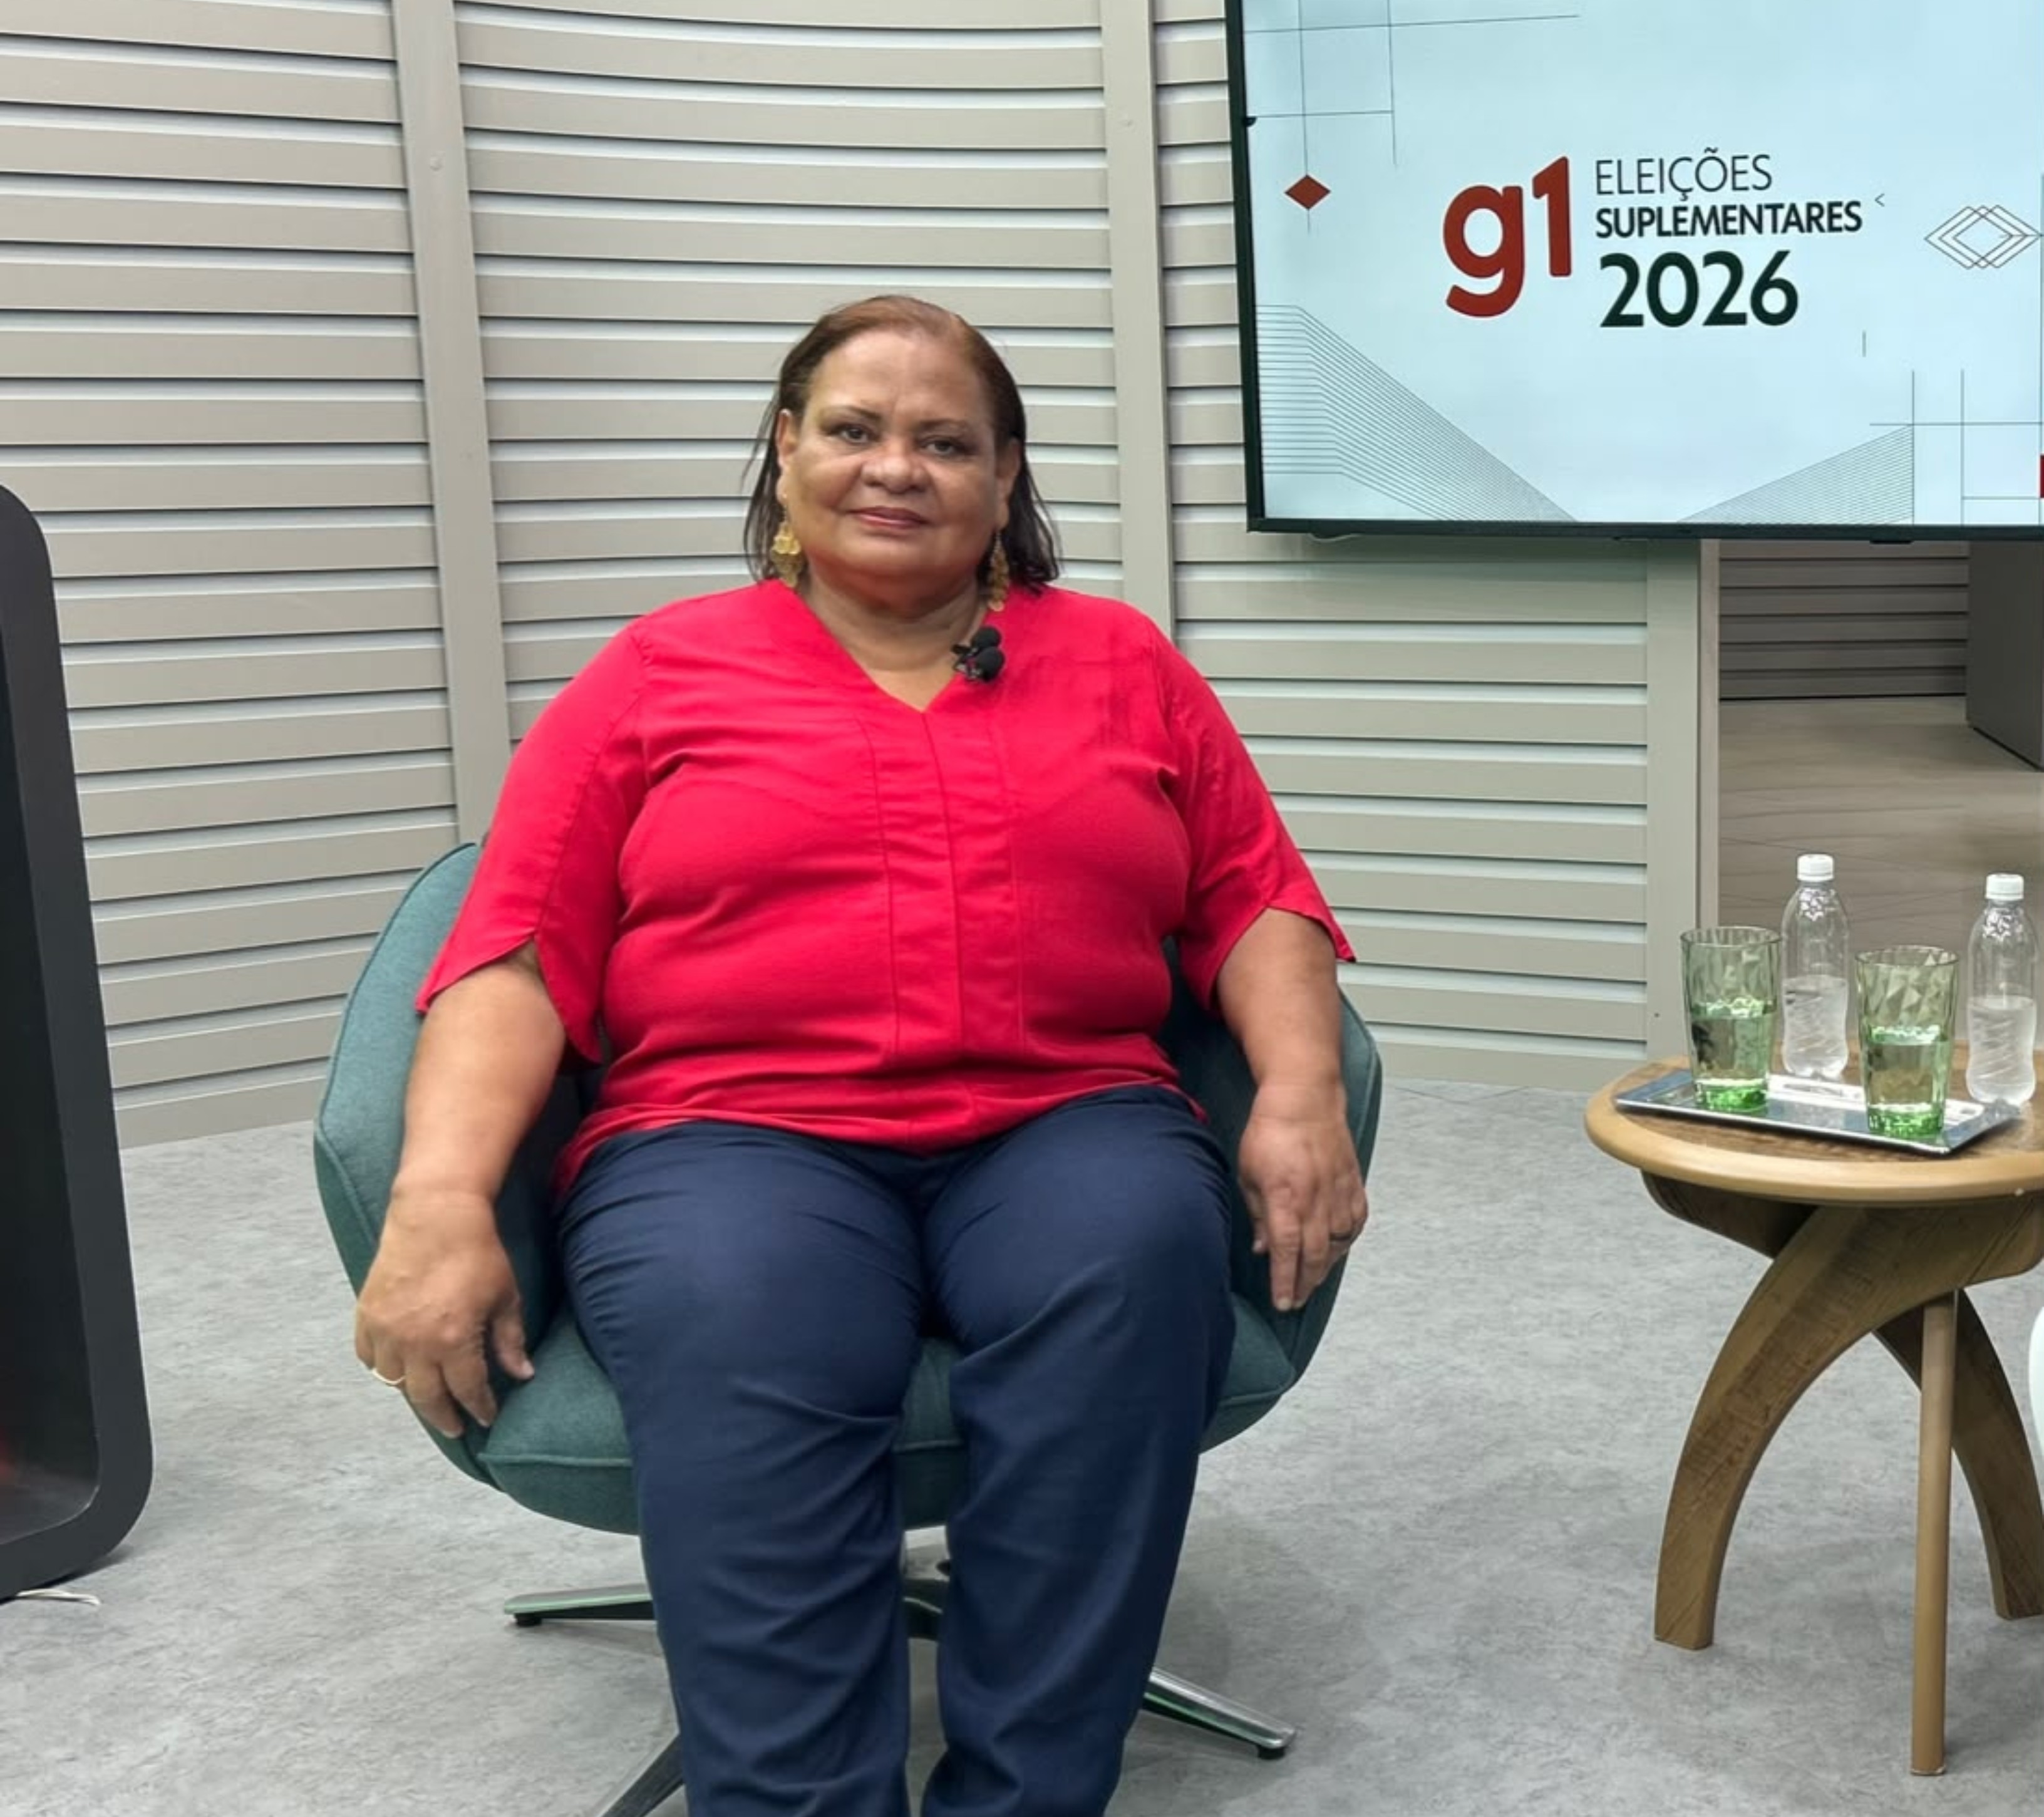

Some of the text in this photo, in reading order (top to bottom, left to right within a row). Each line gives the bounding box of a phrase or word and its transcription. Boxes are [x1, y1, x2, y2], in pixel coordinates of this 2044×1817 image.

[1596, 147, 1773, 202] ELEIÇÕES
[1443, 156, 1572, 318] g1
[1596, 200, 1863, 239] SUPLEMENTARES
[1599, 250, 1799, 328] 2026
